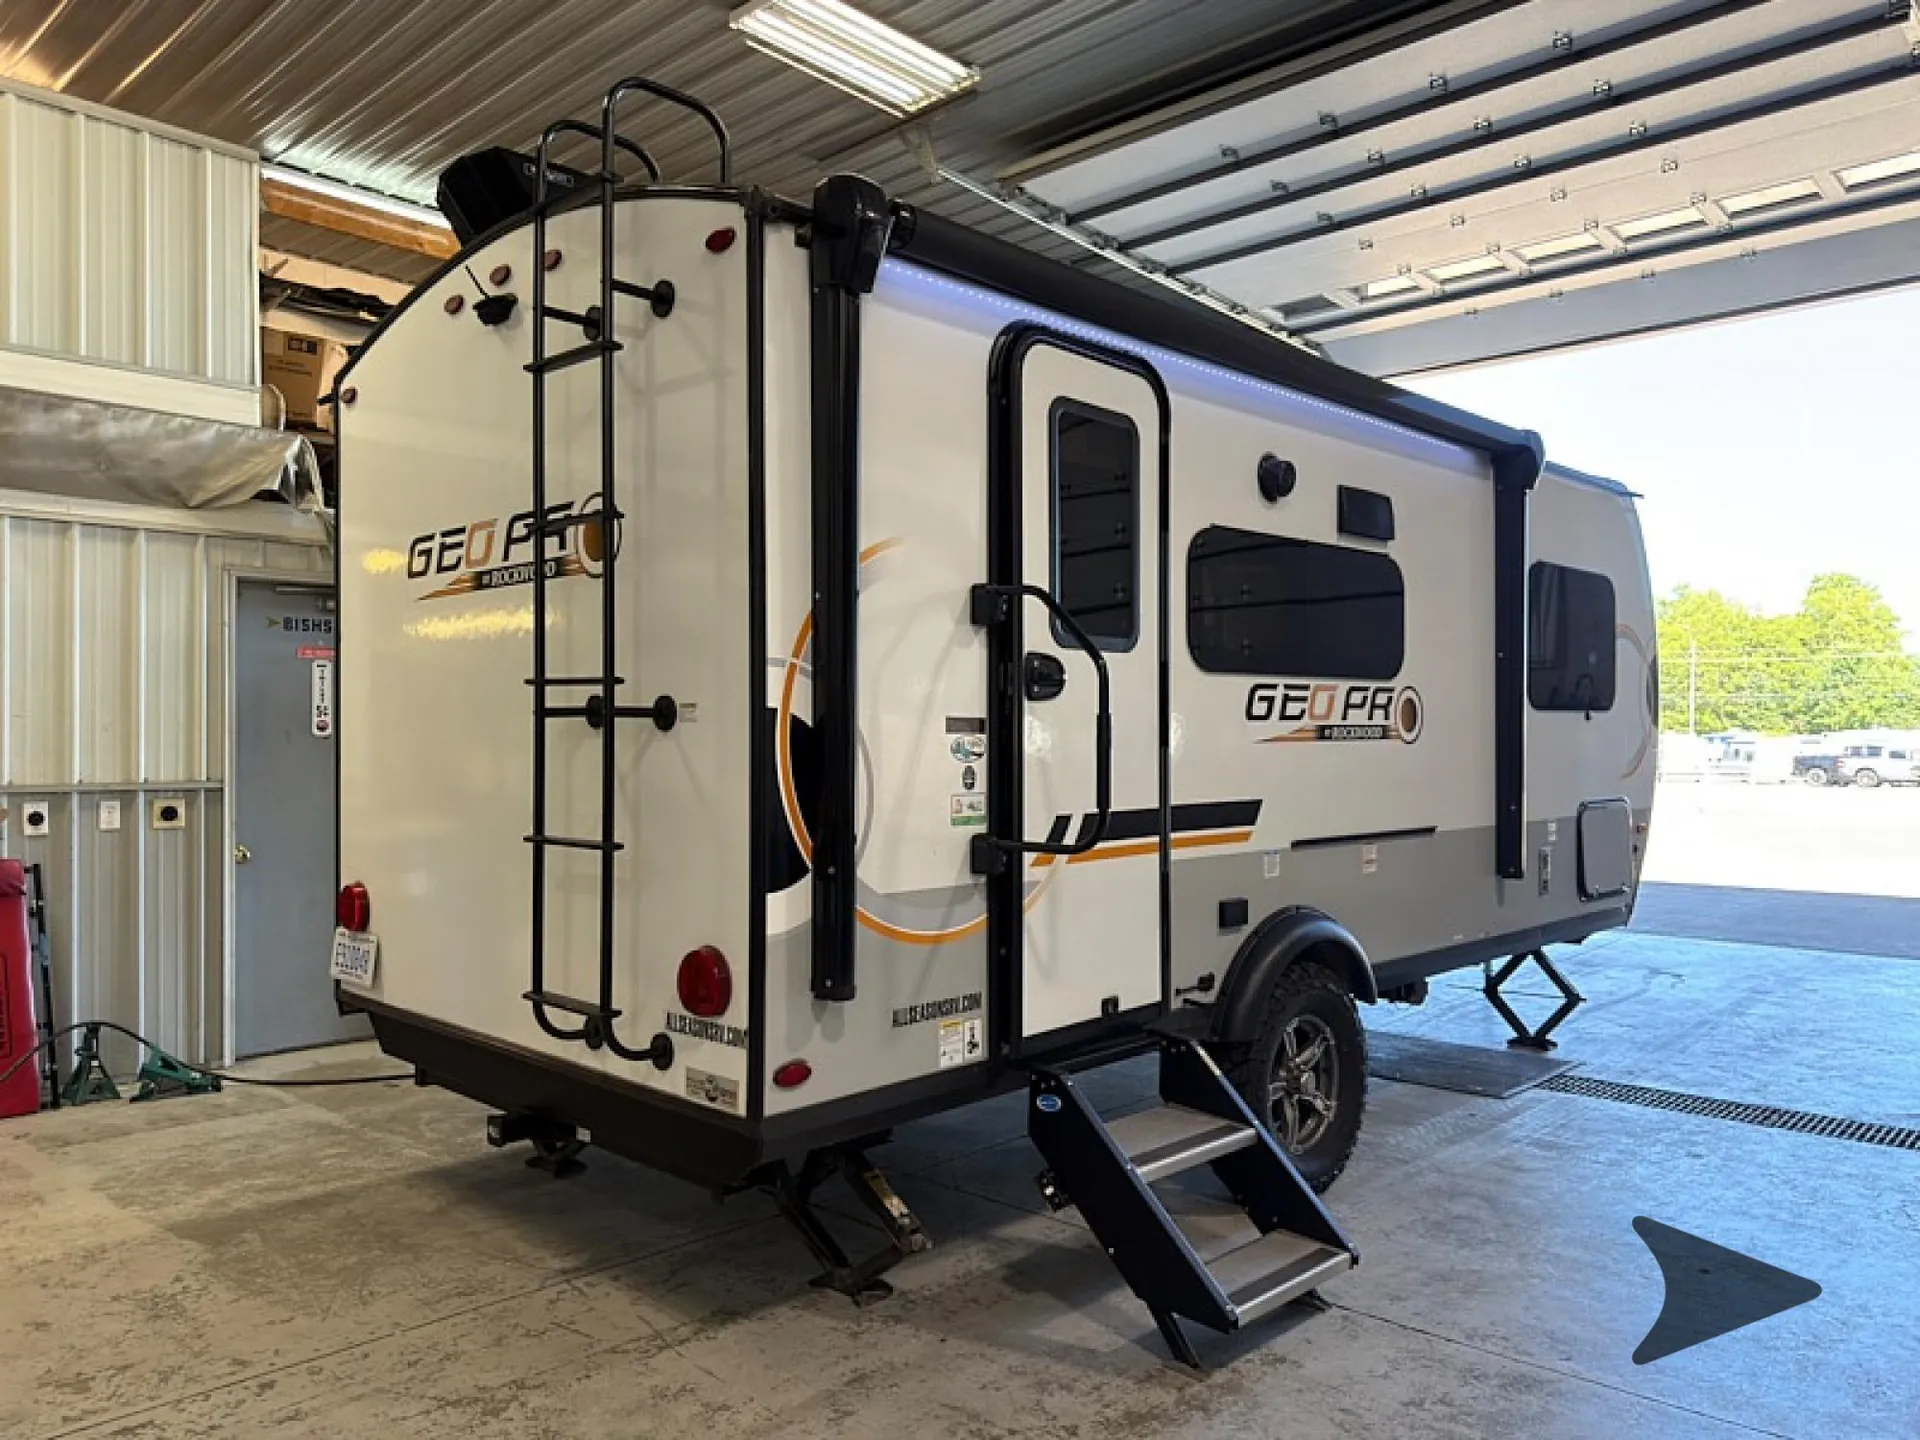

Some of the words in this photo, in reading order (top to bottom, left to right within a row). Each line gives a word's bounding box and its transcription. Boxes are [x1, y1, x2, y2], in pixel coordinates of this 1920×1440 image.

[407, 518, 500, 579] GEO
[1245, 683, 1339, 721] GEO
[1341, 685, 1424, 744] PRO
